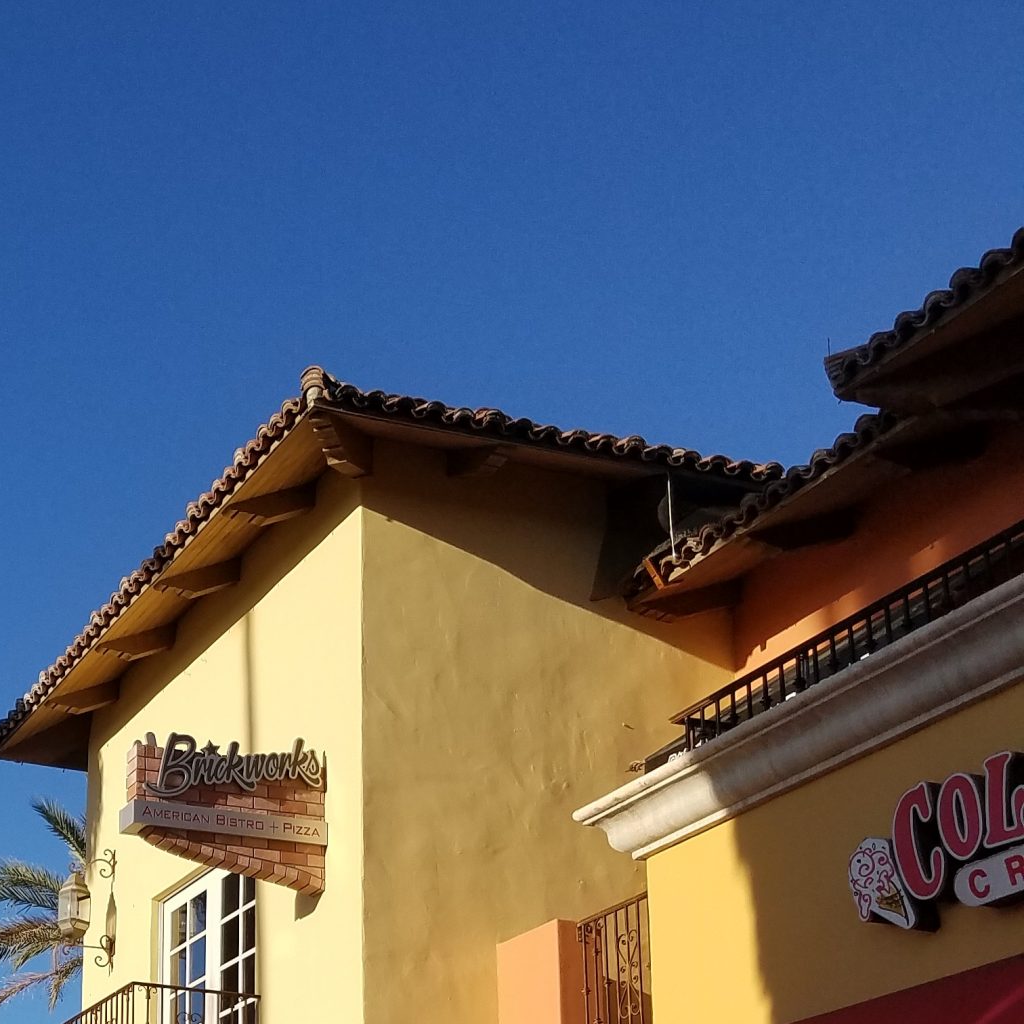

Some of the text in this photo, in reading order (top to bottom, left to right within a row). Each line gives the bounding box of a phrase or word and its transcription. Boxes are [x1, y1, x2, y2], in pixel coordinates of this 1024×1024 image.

[143, 732, 321, 797] Brickworks
[142, 806, 210, 825] AMERICAN
[216, 815, 264, 831] BISTRO
[282, 822, 320, 838] PIZZA
[968, 854, 1024, 898] CR
